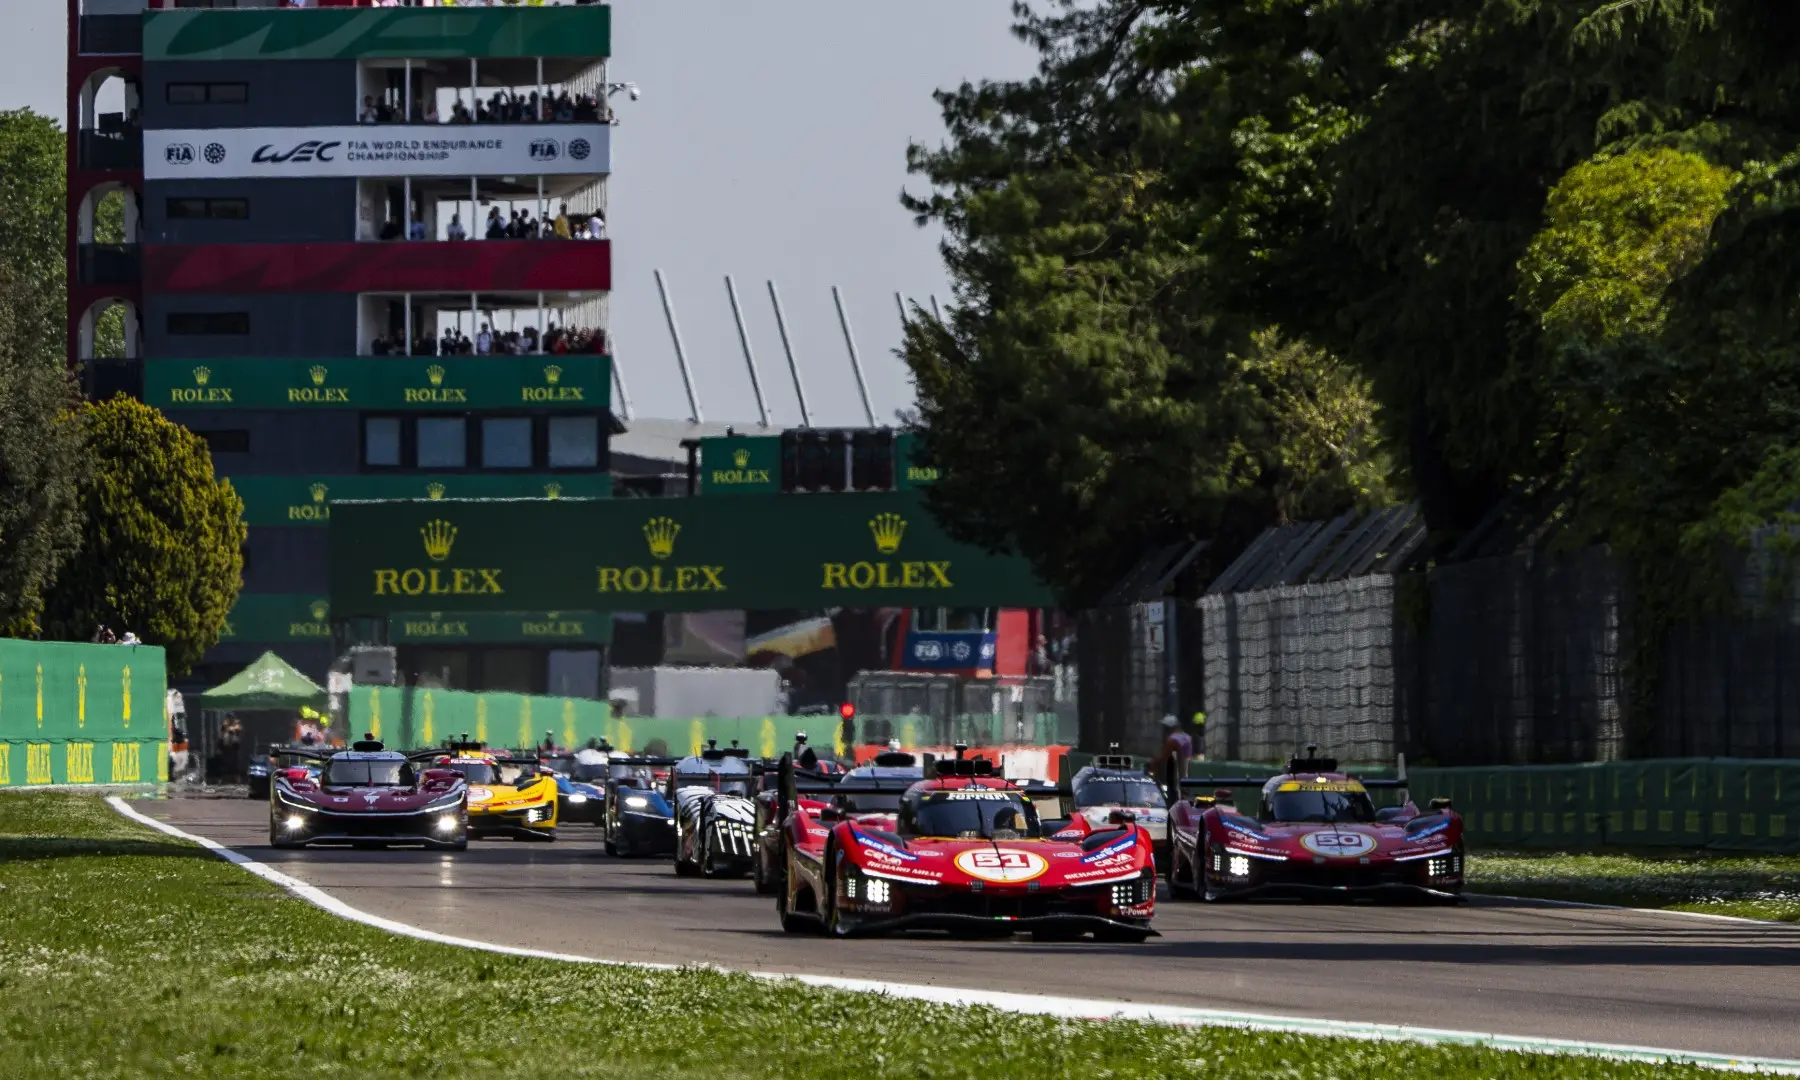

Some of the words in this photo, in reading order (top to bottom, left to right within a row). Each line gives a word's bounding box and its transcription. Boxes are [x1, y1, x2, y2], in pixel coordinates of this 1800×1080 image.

[252, 141, 341, 163] WEC
[348, 141, 368, 150] FIA
[373, 140, 418, 150] WORLD
[423, 140, 502, 149] ENDURANCE
[166, 145, 194, 162] FIA
[347, 151, 449, 161] CHAMPIONSHIP
[170, 388, 233, 402] ROLEX
[288, 388, 349, 402] ROLEX
[404, 388, 467, 402] ROLEX
[521, 387, 584, 400] ROLEX
[712, 470, 770, 483] ROLEX
[288, 505, 330, 519] ROL
[374, 567, 504, 595] ROLEX
[597, 565, 726, 593] ROLEX
[821, 560, 953, 589] ROLEX
[405, 621, 468, 636] ROLEX
[522, 621, 584, 635] ROLEX
[946, 792, 1010, 800] Ferrari
[1317, 834, 1361, 847] 50
[972, 853, 1029, 868] 51
[867, 861, 911, 873] RICHARD
[912, 868, 944, 878] MILLE
[1064, 869, 1106, 880] RICHARD
[1106, 863, 1134, 875] MILLE
